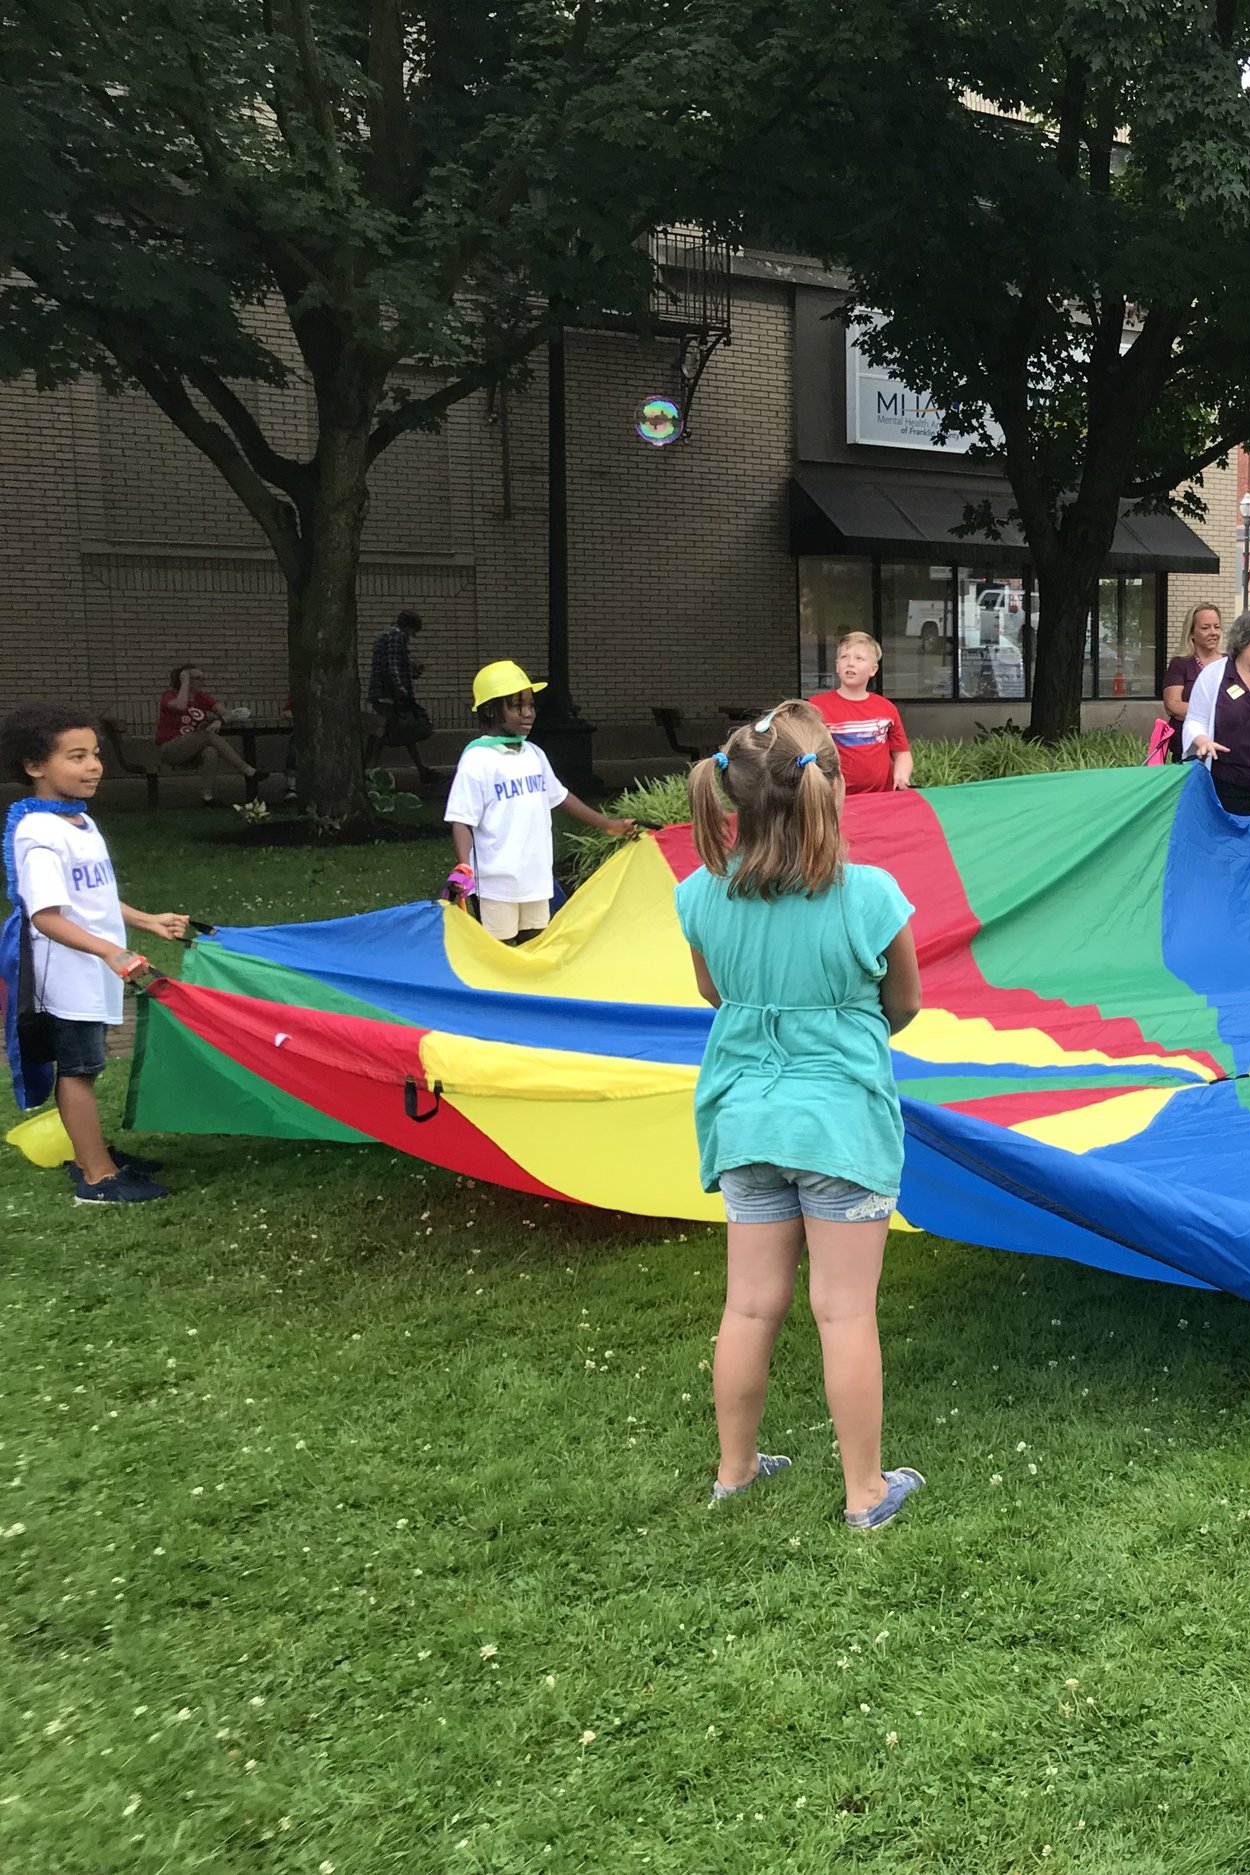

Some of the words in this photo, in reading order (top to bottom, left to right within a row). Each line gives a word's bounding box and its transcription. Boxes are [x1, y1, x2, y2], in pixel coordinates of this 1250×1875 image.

[877, 415, 902, 426] Mental
[905, 418, 930, 429] Health
[494, 778, 524, 801] PLAY
[72, 861, 109, 891] PLAY
